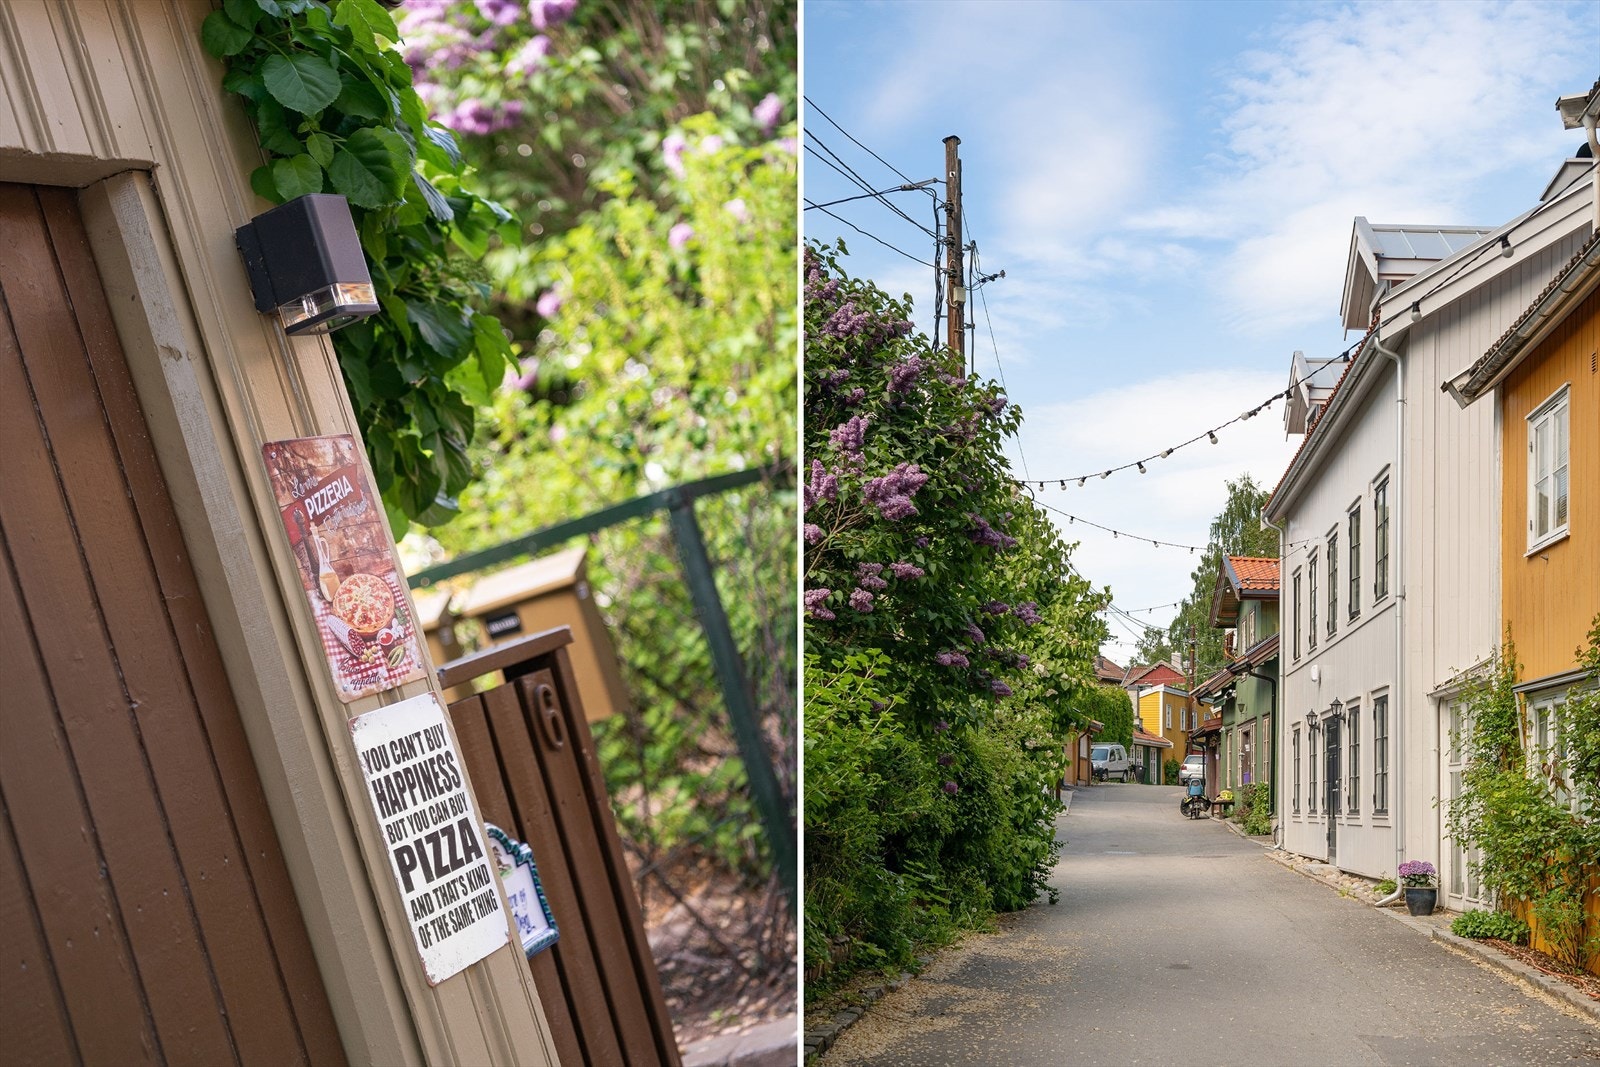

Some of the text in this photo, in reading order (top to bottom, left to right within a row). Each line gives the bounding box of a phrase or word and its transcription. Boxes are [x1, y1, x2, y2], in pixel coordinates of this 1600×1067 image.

[304, 475, 354, 520] PIZZERIA
[536, 684, 563, 747] 6
[362, 723, 447, 775] YOU CAN'T BUY
[371, 750, 462, 819] HAPPINESS
[385, 792, 468, 845] BUT YOU CAN BUY
[393, 817, 483, 894] PIZZA
[410, 864, 491, 922] AND THAT'S KIND
[418, 923, 433, 949] OF
[430, 914, 452, 943] THE
[449, 901, 476, 934] SAME
[472, 889, 499, 920] THING
